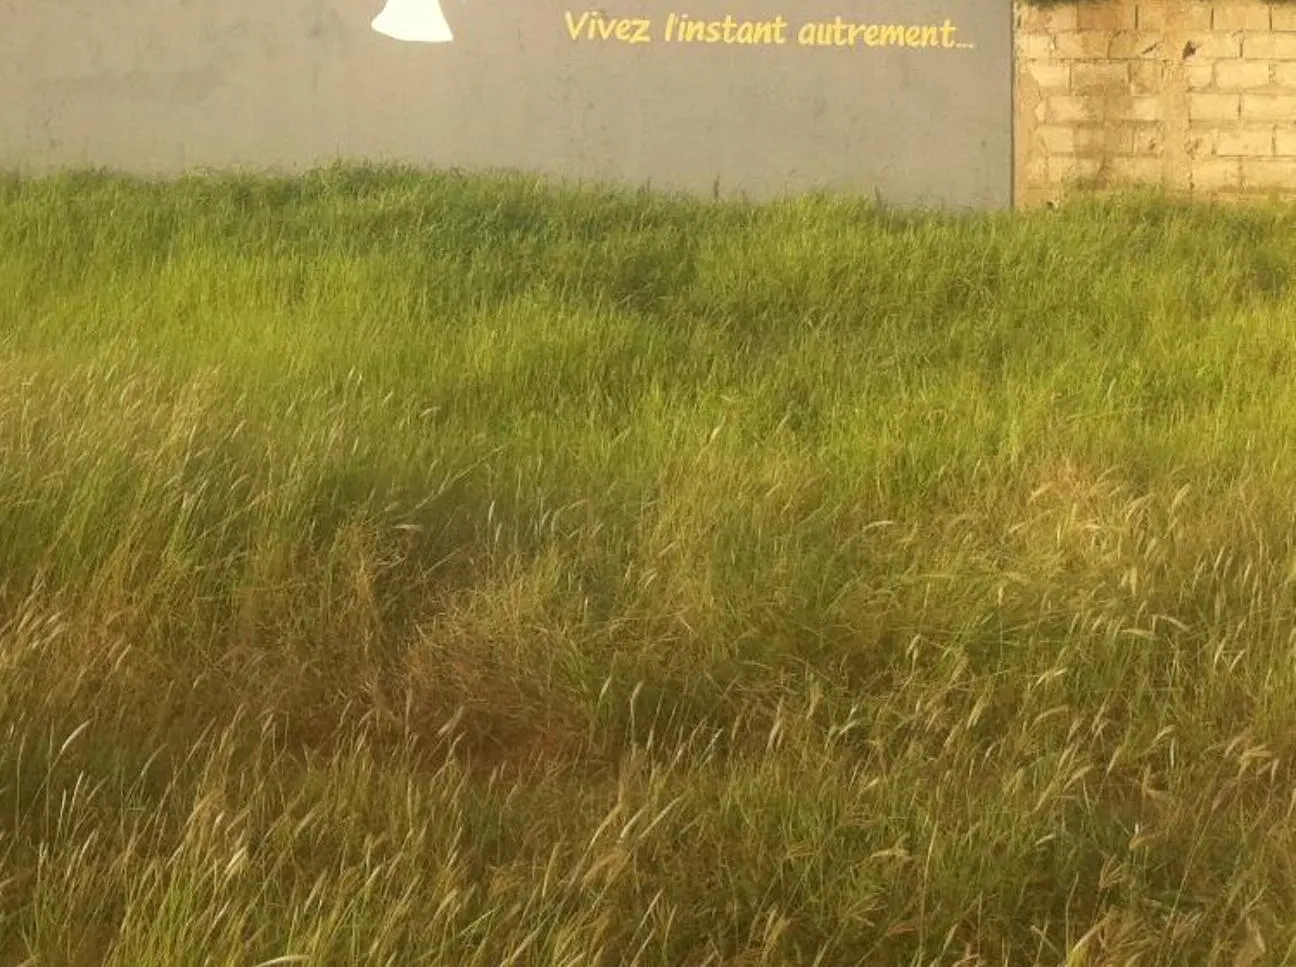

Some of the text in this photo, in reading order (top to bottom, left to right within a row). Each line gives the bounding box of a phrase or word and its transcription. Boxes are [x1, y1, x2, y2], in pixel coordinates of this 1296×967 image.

[564, 11, 974, 49] Vivez l'instant autrement...
